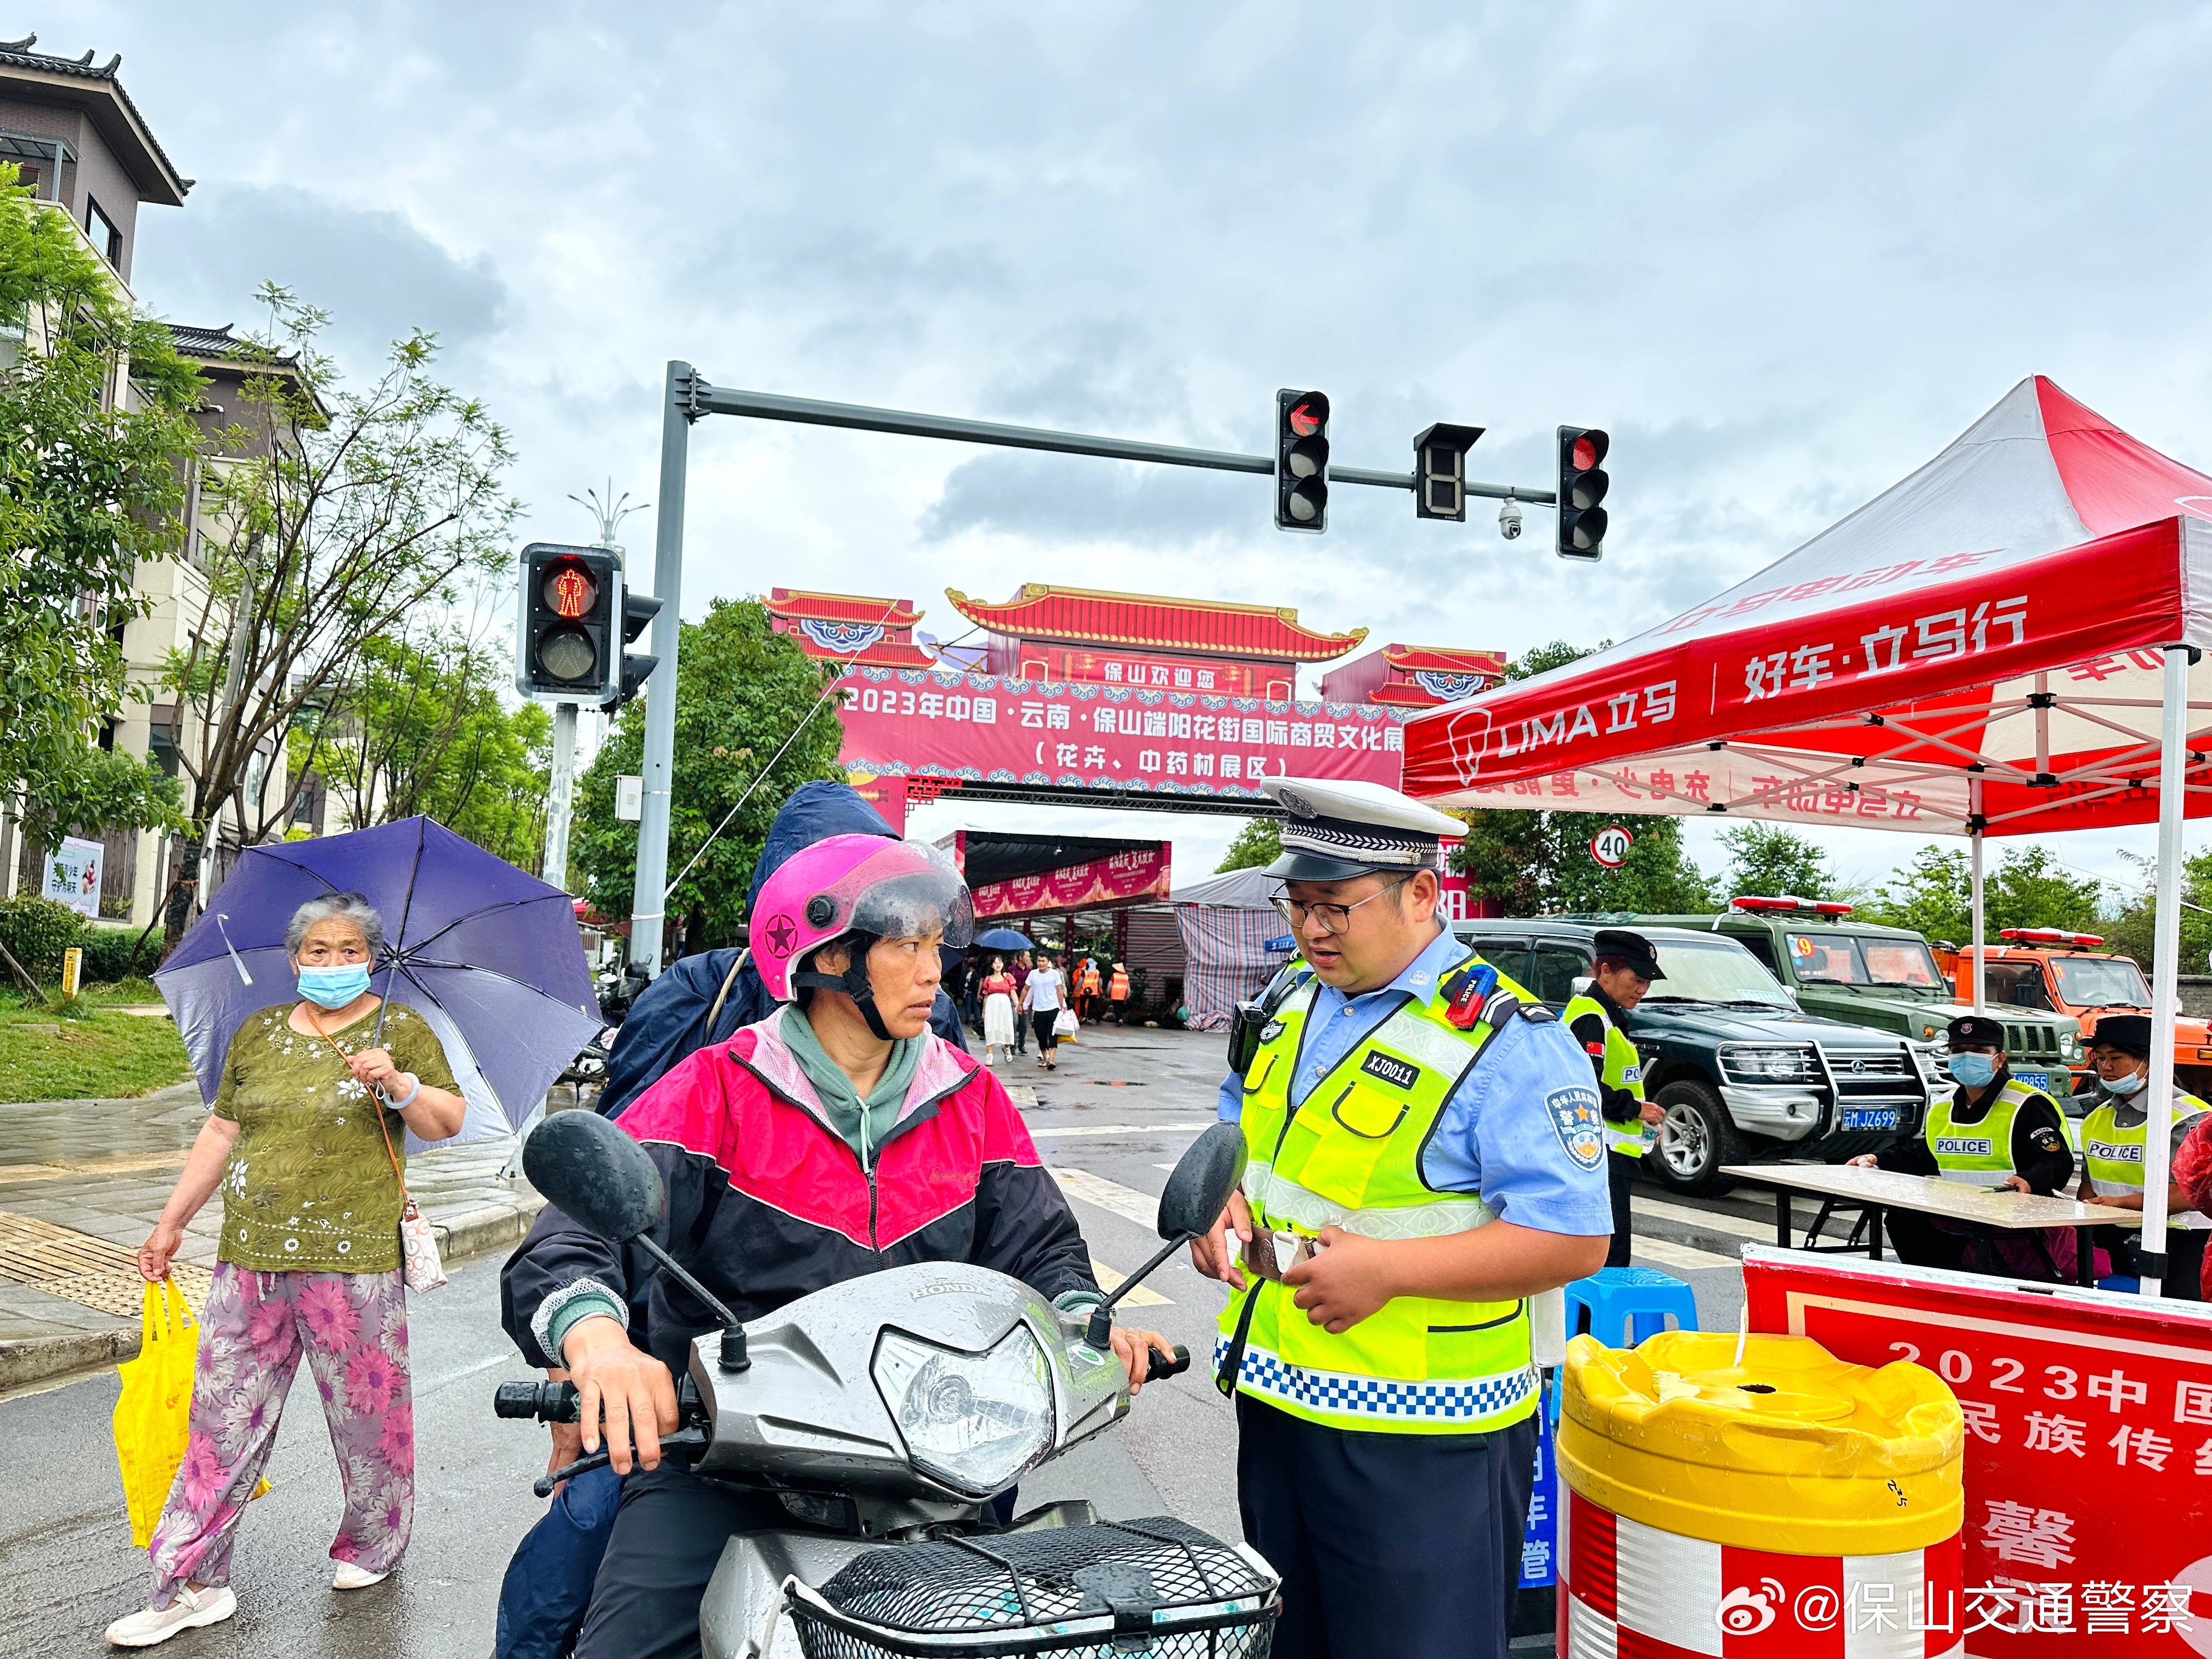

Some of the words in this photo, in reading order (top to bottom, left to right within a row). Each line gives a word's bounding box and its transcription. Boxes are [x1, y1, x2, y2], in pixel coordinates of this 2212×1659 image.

[1651, 549, 2006, 637] 立马电动车
[1104, 662, 1216, 690] 保山欢迎您
[1498, 705, 1599, 758] LIMA
[1606, 680, 1677, 734] 立马
[1743, 595, 2028, 704] 好车·立马行
[1600, 836, 1624, 856] 40
[1799, 938, 1812, 955] 9
[1460, 979, 1478, 1003] POLICE
[1367, 1056, 1413, 1085] XJ0011
[1625, 1068, 1641, 1080] PO
[1551, 1091, 1598, 1110] 中华人民共和国
[1575, 1125, 1594, 1133] POLICE
[1938, 1141, 1987, 1153] POLICE
[2089, 1143, 2138, 1160] POLICE
[909, 1284, 991, 1299] HONDA
[1980, 1500, 2076, 1570] 馨
